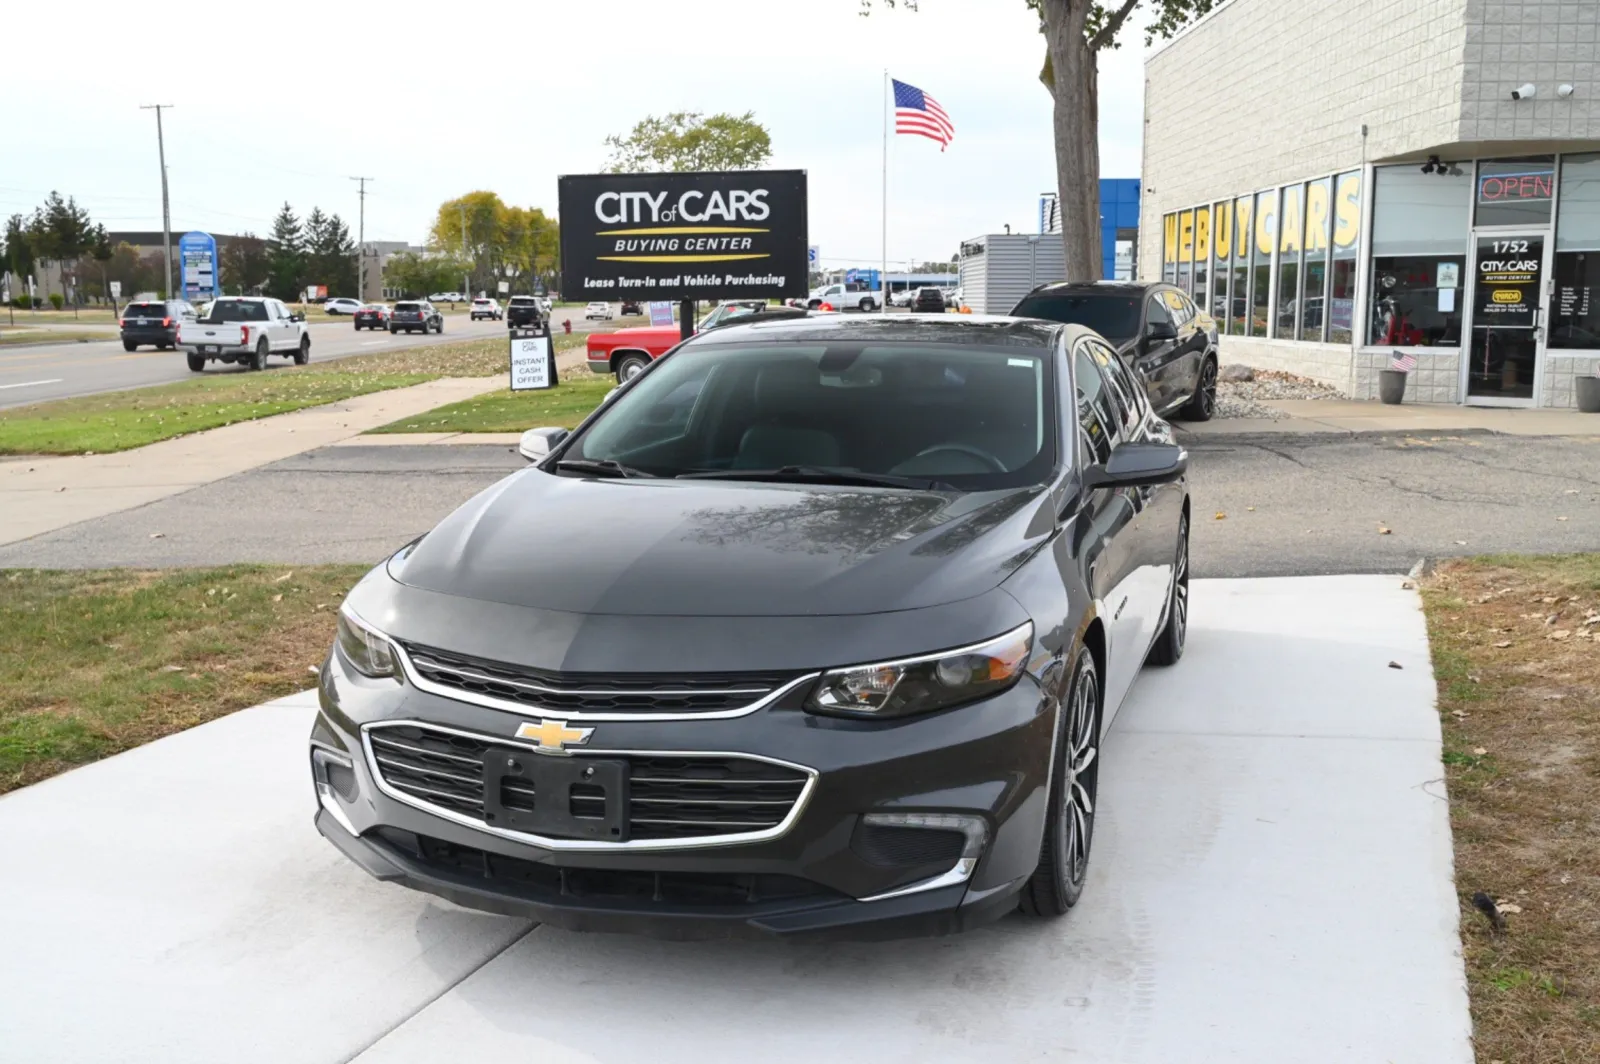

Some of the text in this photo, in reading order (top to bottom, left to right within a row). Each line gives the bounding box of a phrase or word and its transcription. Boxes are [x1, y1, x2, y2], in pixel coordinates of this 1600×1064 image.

[1482, 175, 1553, 199] OPEN
[595, 189, 770, 223] CITY of CARS
[614, 237, 752, 252] BUYING CENTER
[1492, 240, 1529, 253] 1752
[1480, 260, 1505, 271] CITY
[1508, 260, 1538, 271] CARS
[583, 273, 786, 288] Lease Turn-In and Vehicle Purchasing
[513, 357, 546, 366] INSTANT
[517, 375, 543, 383] OFFER
